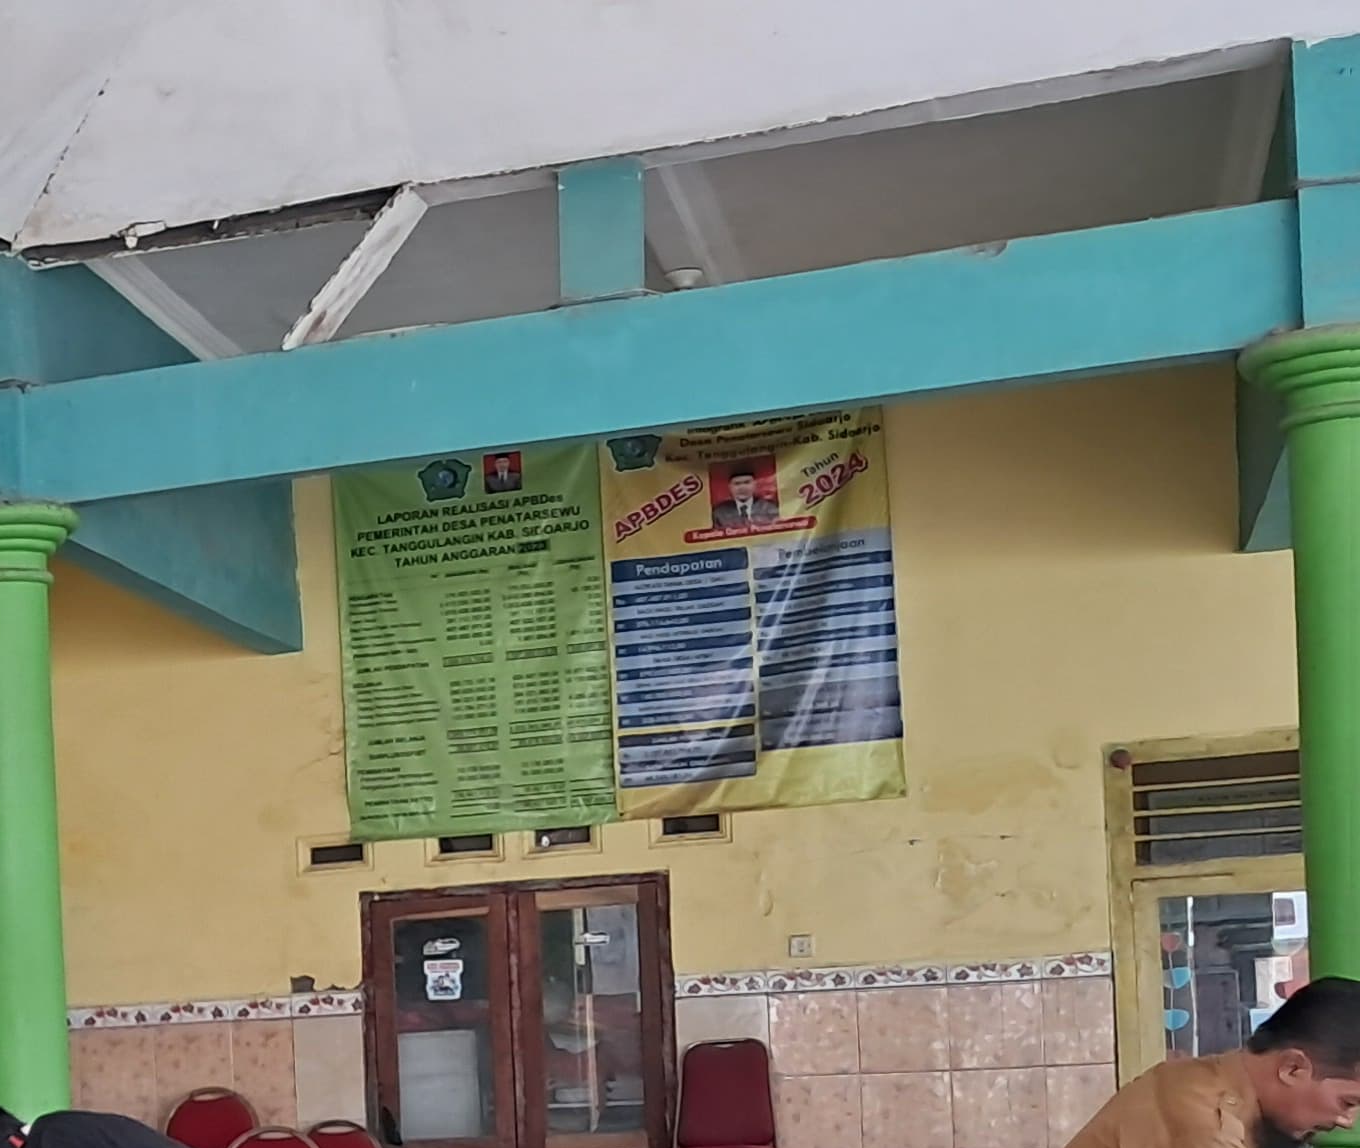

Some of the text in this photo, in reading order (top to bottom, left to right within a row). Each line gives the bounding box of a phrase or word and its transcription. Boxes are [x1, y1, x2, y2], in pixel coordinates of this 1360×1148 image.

[827, 422, 881, 443] Sidoarjo
[800, 451, 840, 478] Tahun
[799, 450, 866, 506] 2024
[377, 507, 440, 525] LAPORAN
[442, 499, 510, 519] REALISASI
[615, 474, 702, 540] APBDES
[357, 505, 581, 542] PEMERINTAH DESA PENATARSEWU
[382, 533, 484, 554] TANGGULANGIN
[395, 553, 438, 569] TAHUN
[441, 544, 516, 562] ANGGARAN
[635, 557, 723, 577] Pendapatan
